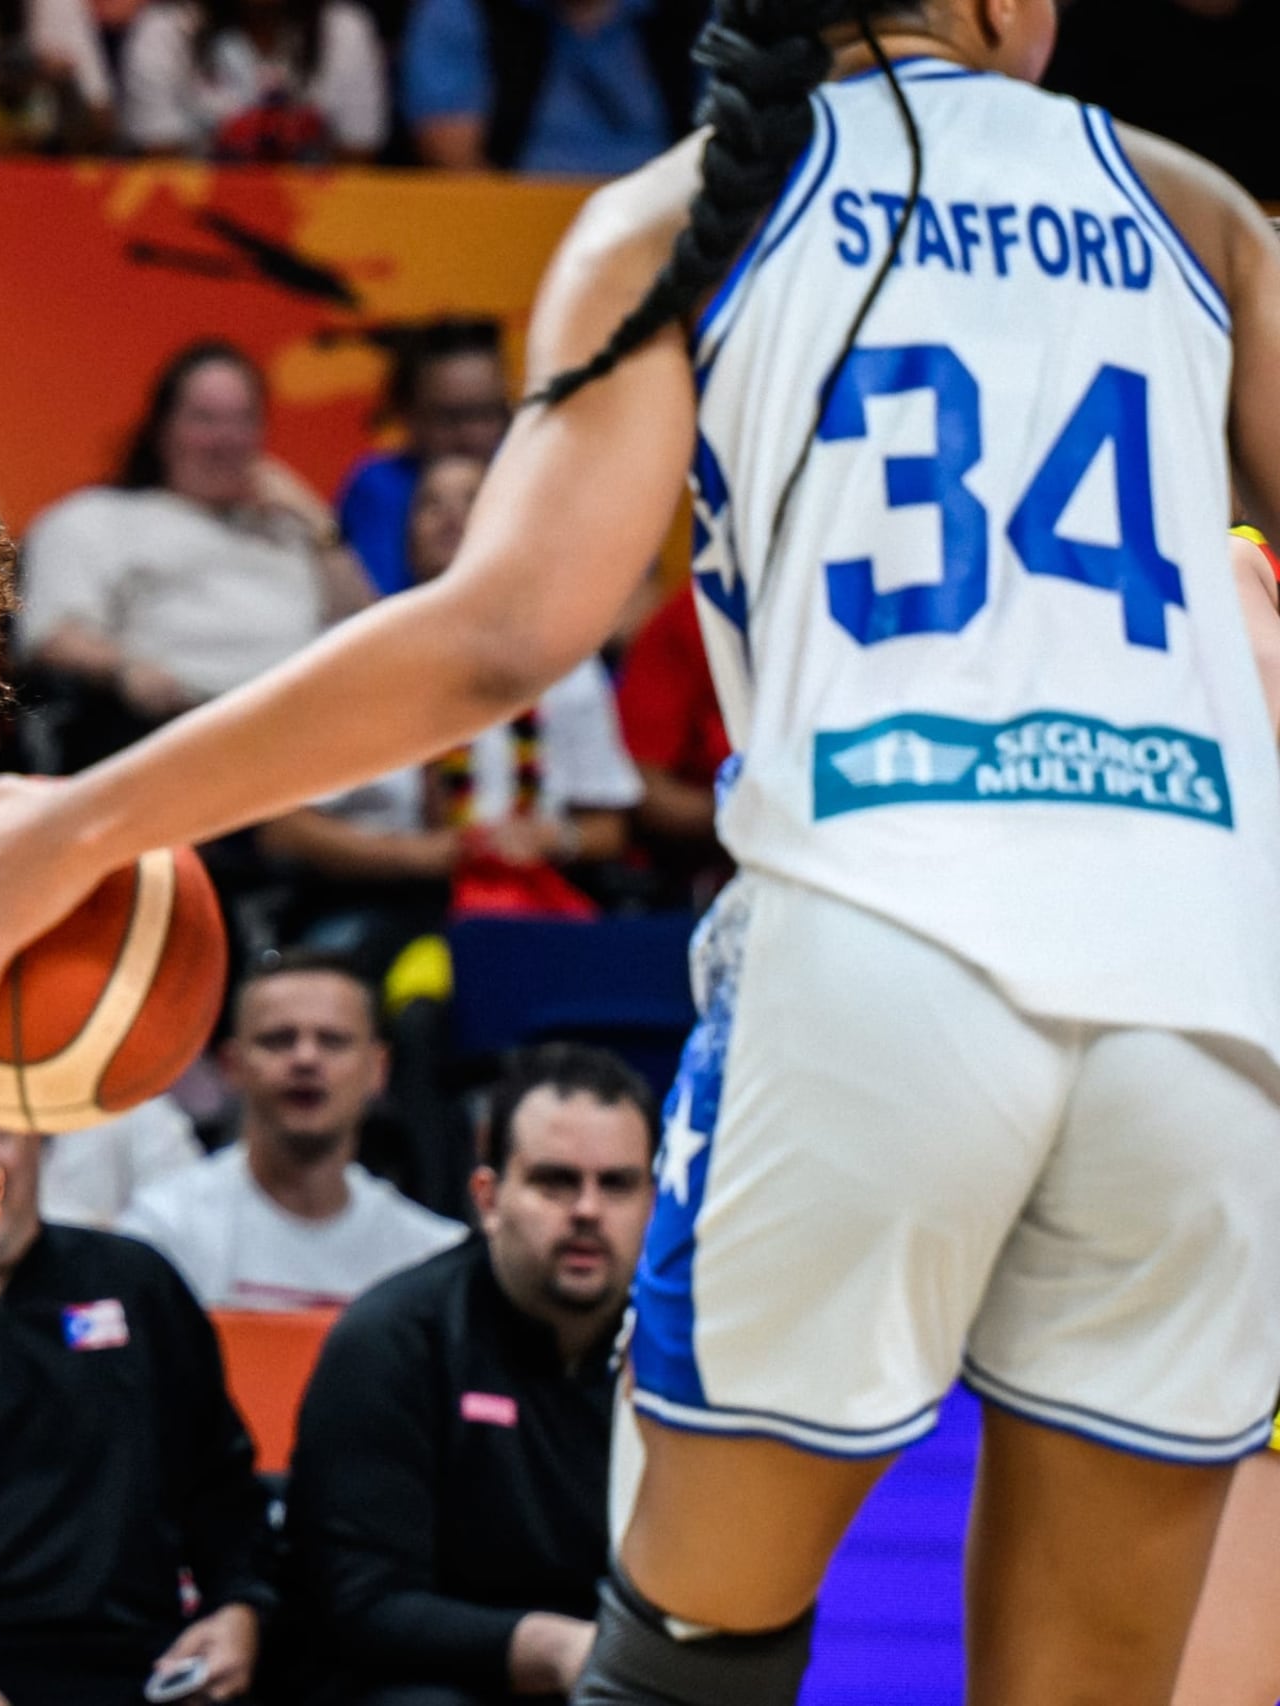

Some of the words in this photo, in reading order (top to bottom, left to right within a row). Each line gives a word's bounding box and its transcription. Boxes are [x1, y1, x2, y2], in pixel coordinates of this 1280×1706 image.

[830, 187, 1153, 291] STAFFORD
[815, 344, 1187, 651] 34
[994, 720, 1198, 776] SEGUROS
